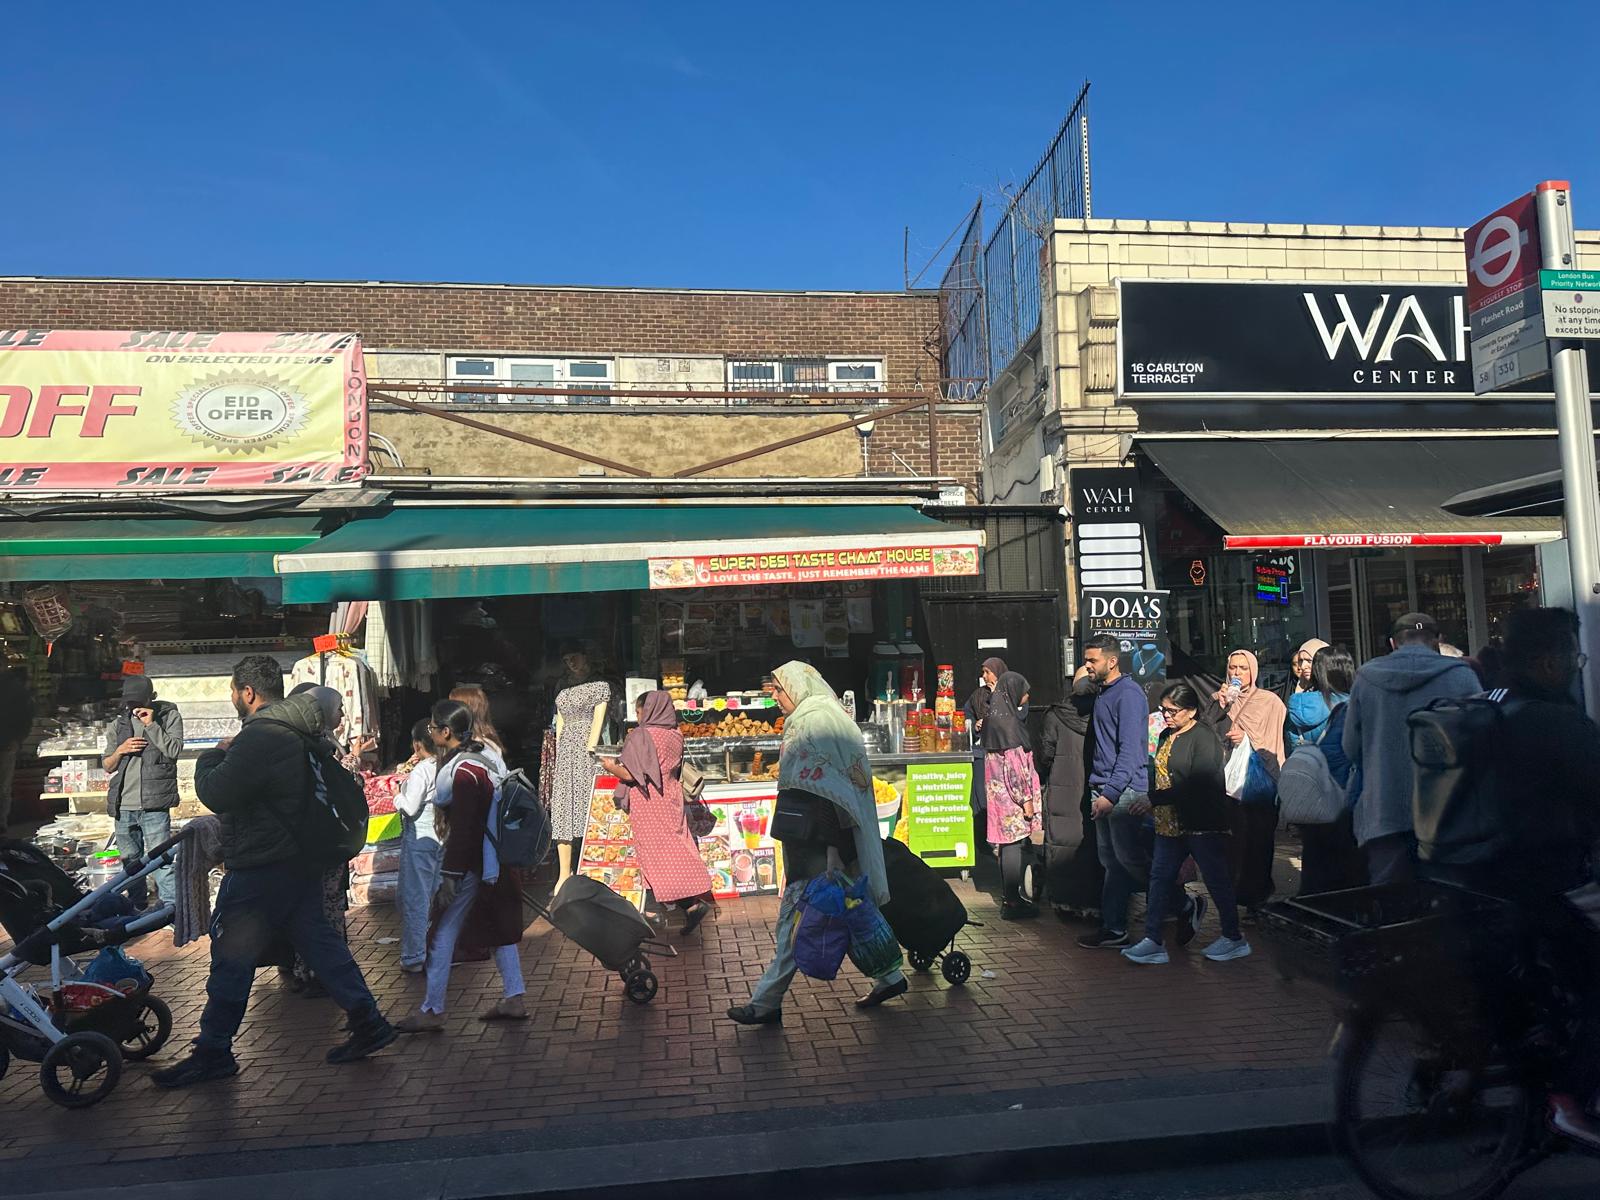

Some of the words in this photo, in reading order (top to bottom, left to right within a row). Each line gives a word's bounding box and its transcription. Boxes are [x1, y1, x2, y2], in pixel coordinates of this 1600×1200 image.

[1506, 282, 1522, 293] STOP
[1551, 280, 1573, 288] Priority
[1506, 300, 1524, 313] Road
[1555, 305, 1567, 313] No
[1569, 306, 1600, 315] stoppin
[1568, 317, 1582, 325] any
[1555, 327, 1582, 335] except
[120, 332, 222, 348] SALE
[146, 355, 175, 363] ON
[178, 355, 274, 364] SELECTED
[1131, 364, 1144, 373] 16
[1146, 363, 1203, 373] CARLTON
[1498, 361, 1515, 376] 330
[1131, 374, 1196, 384] TERRACET
[1353, 370, 1455, 384] CENTER
[1480, 372, 1489, 383] 58
[225, 396, 260, 408] EID
[0, 385, 142, 438] OFF
[348, 361, 362, 457] LONDON
[208, 409, 273, 421] OFFER
[116, 467, 218, 485] SALE
[264, 466, 366, 485] SALE
[1083, 487, 1133, 504] WAH
[1304, 536, 1362, 545] FLAVOUR
[1366, 535, 1412, 545] FUSION
[709, 556, 756, 571] SUPER
[760, 554, 789, 569] DESI
[793, 553, 835, 568] TASTE
[838, 551, 882, 566] CHAAT
[887, 549, 931, 563] HOUSE
[714, 574, 738, 582] LOVE
[741, 573, 762, 581] THE
[764, 572, 796, 581] TASTE,
[798, 570, 820, 580] JUST
[823, 567, 877, 578] REMEMBER
[880, 566, 899, 575] THE
[901, 565, 929, 575] NAME
[1090, 594, 1161, 619] DOA'S
[1089, 619, 1161, 629] JEWELLERY
[922, 783, 963, 791] Nutritious
[916, 795, 933, 803] High
[944, 793, 964, 801] Fibre
[912, 806, 930, 814] High
[940, 805, 968, 813] Protein
[915, 815, 965, 824] Preservative
